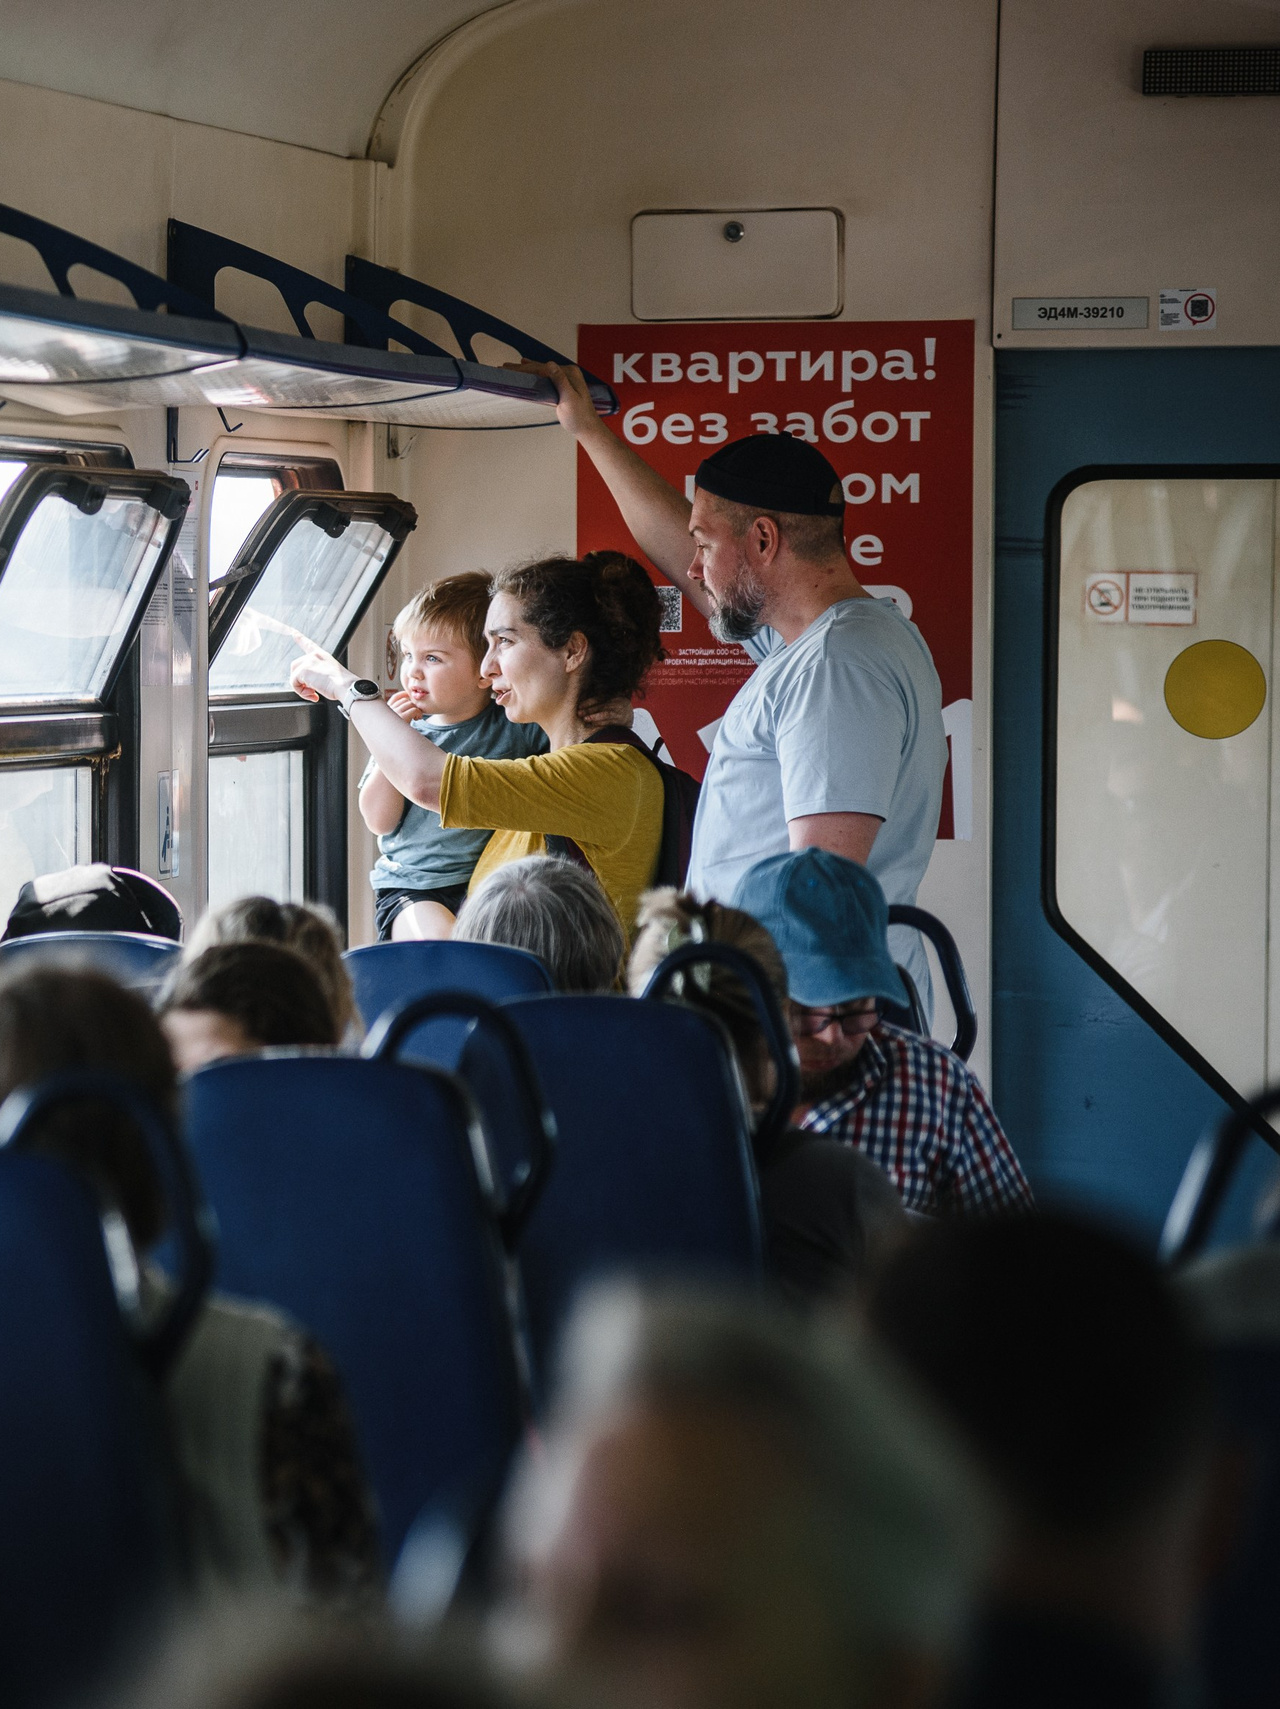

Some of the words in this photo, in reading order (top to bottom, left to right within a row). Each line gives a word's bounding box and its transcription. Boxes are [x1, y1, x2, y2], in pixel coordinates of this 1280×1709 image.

[1037, 306, 1125, 320] ЭД4М-39210
[613, 337, 937, 394] квартира!
[622, 401, 729, 445] без
[750, 399, 931, 443] забот
[678, 647, 715, 656] ЗАСТРОЙЩИК
[716, 648, 729, 656] ООО
[697, 658, 733, 666] ДЕКЛАРАЦИЯ
